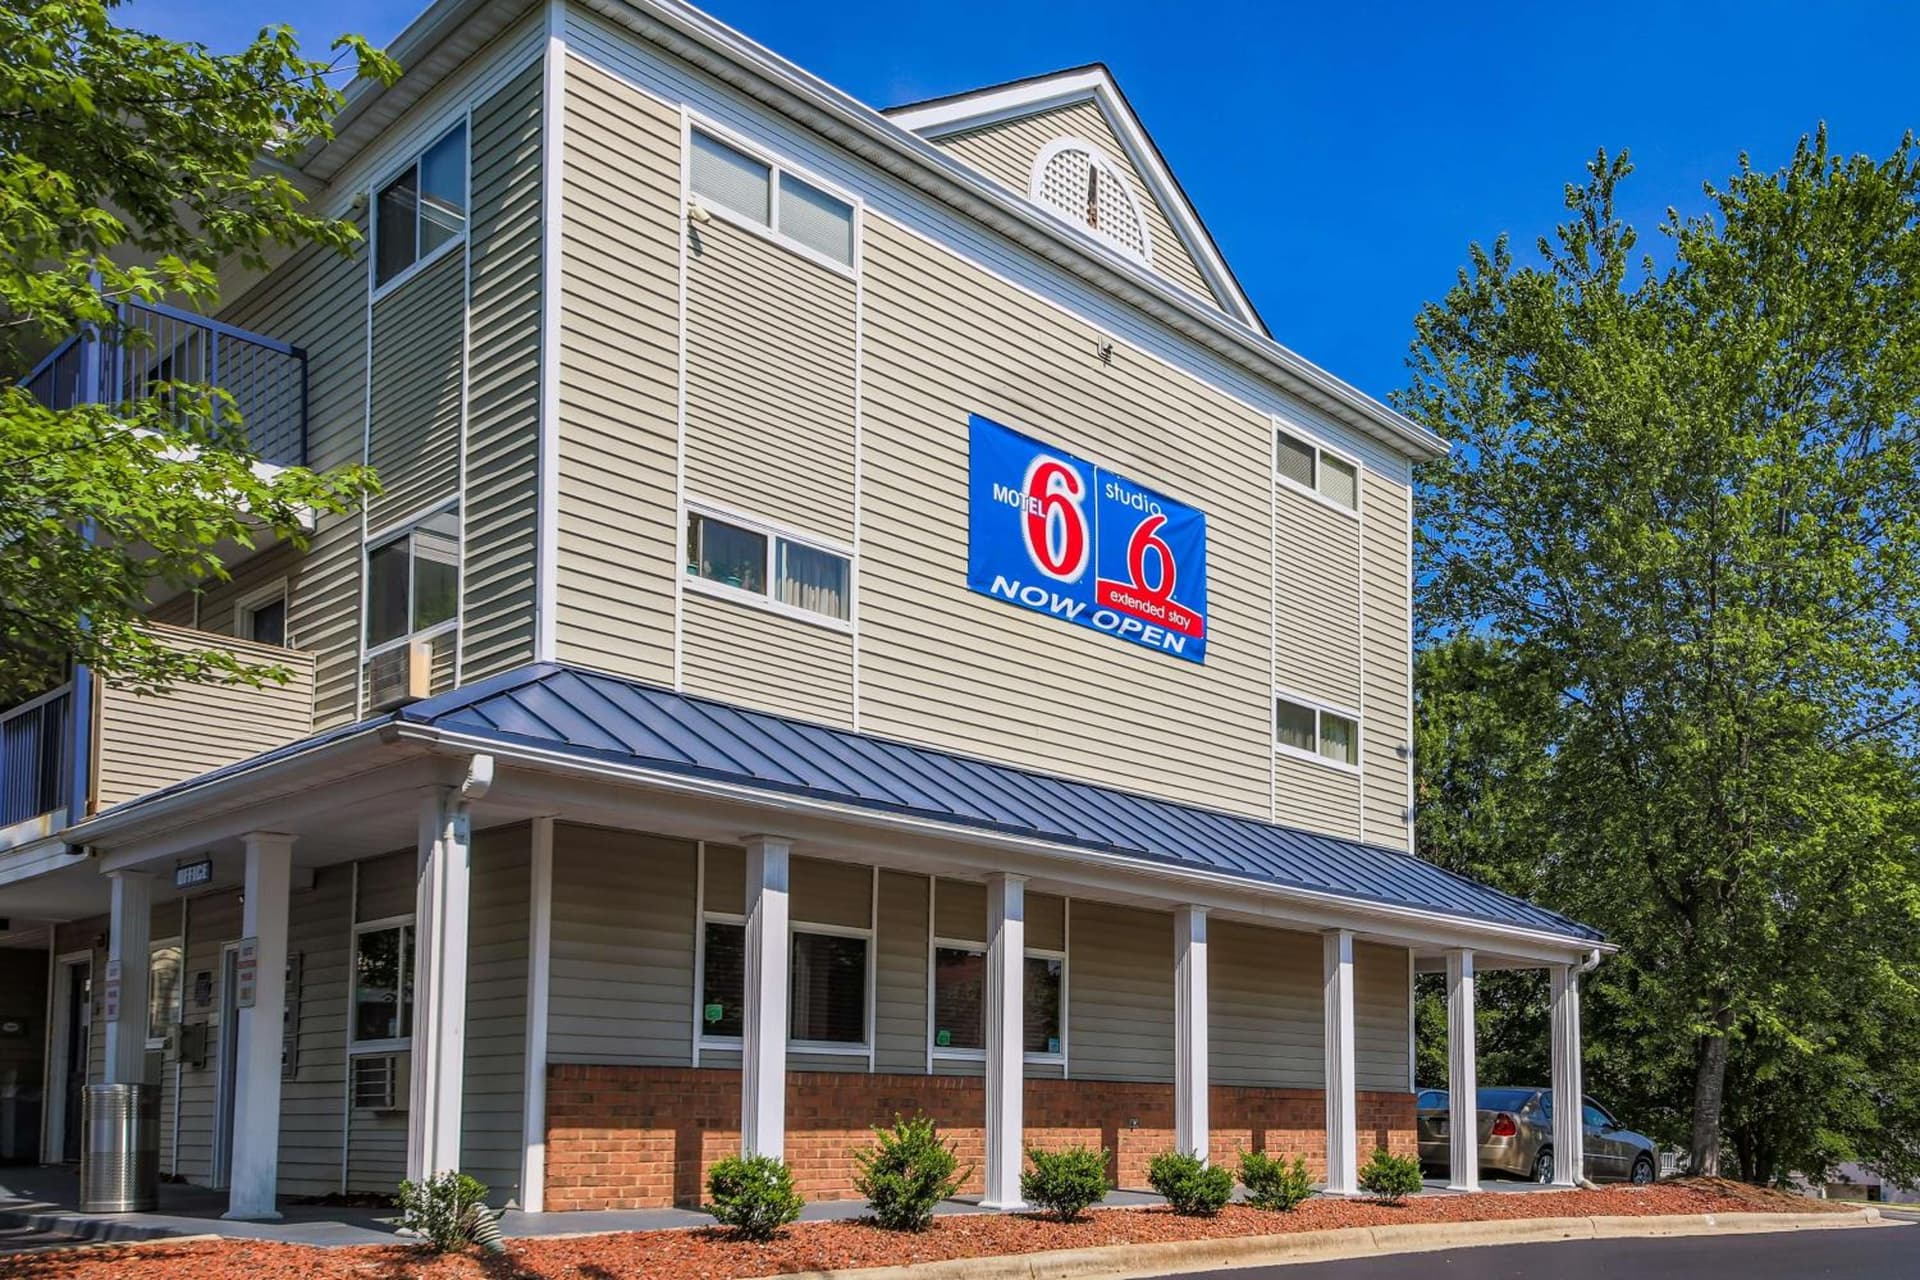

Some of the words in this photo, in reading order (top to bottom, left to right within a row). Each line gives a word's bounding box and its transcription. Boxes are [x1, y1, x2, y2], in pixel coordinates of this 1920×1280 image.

[993, 483, 1046, 518] MOTEL
[1022, 455, 1088, 582] 6
[1105, 482, 1162, 516] studio
[1127, 514, 1177, 600] 6
[990, 575, 1086, 620] NOW
[1092, 610, 1186, 653] OPEN
[1110, 590, 1165, 619] extended
[1168, 610, 1191, 630] stay
[177, 863, 209, 884] OFFICE
